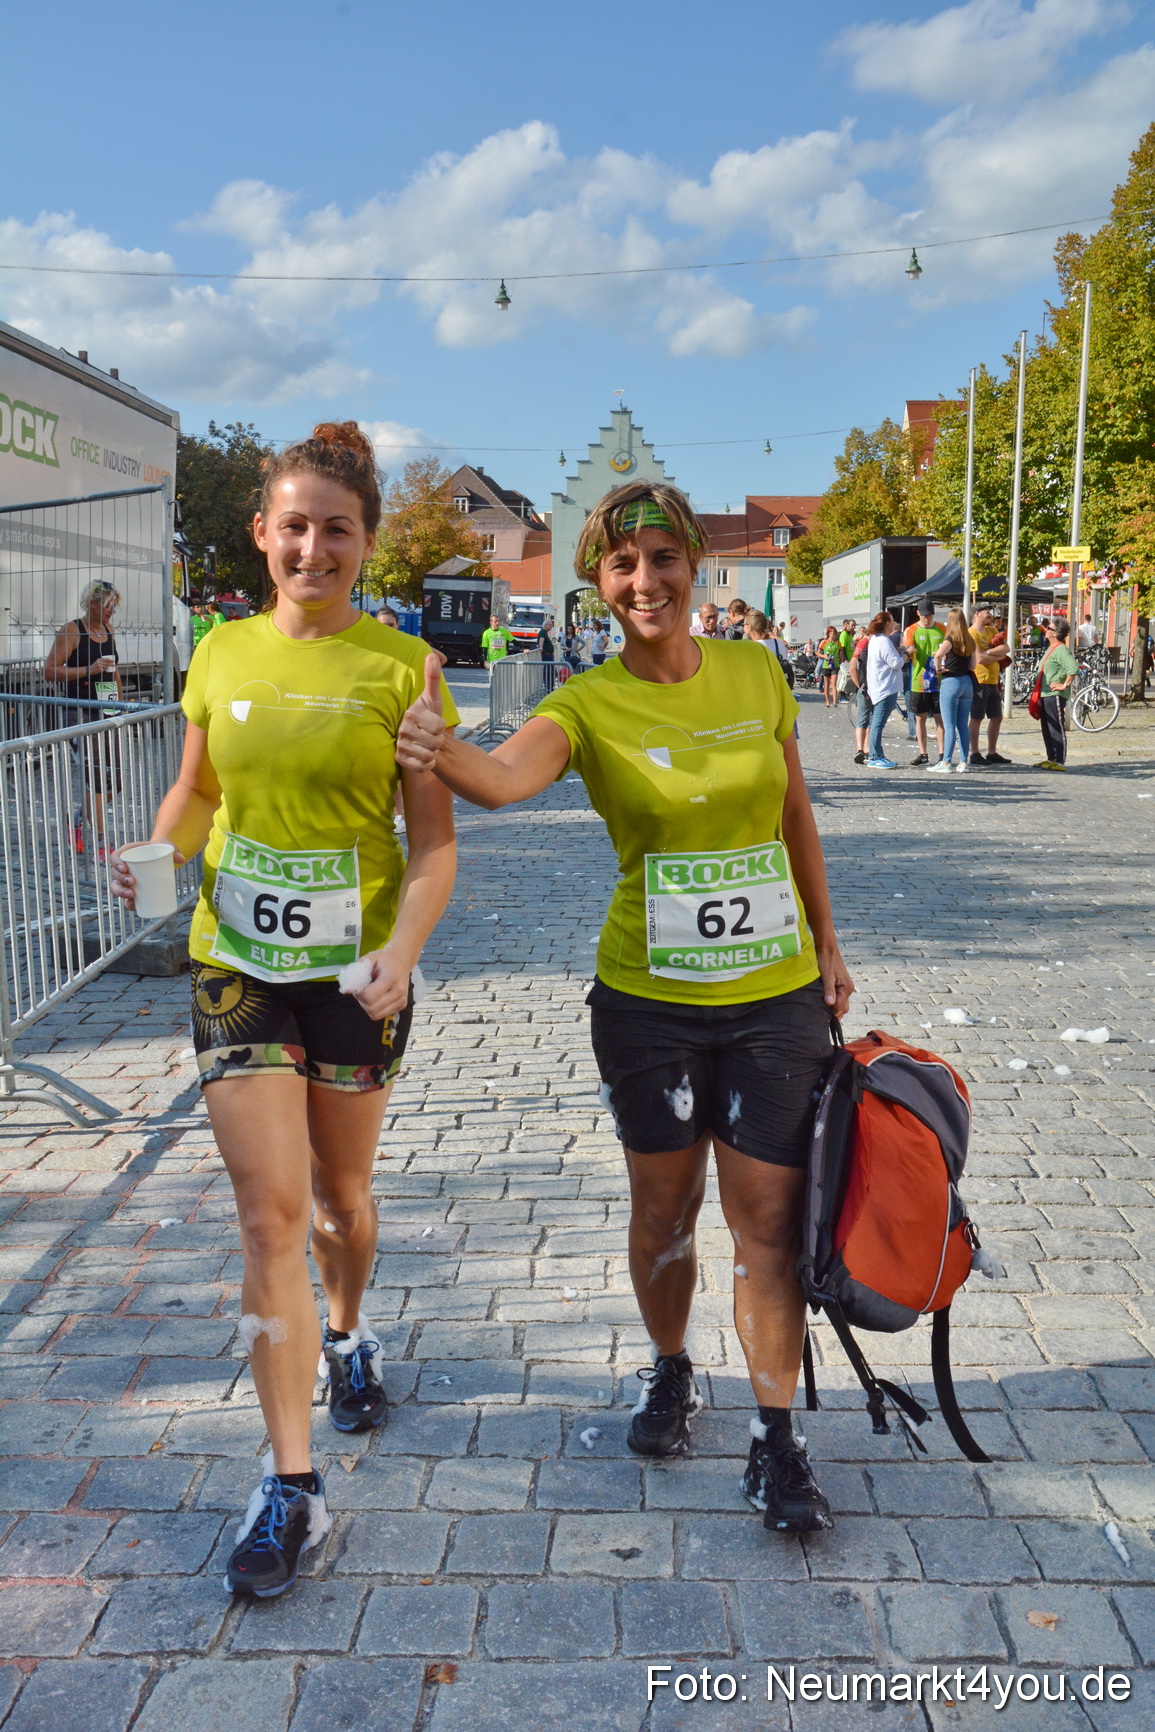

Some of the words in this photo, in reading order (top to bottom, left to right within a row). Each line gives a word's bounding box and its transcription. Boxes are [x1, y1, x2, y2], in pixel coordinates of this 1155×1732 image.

[70, 436, 100, 465] OFFICE
[103, 448, 141, 478] INDUSTRY
[440, 594, 453, 619] now
[284, 692, 313, 700] Kliniken
[693, 728, 721, 738] Kliniken
[721, 724, 732, 732] des
[715, 728, 746, 740] Neumarkt
[231, 842, 344, 887] BOCK
[659, 849, 778, 888] BOCK
[253, 893, 311, 939] 66
[345, 900, 356, 908] E6
[697, 896, 754, 939] 62
[250, 943, 311, 968] ELISA
[668, 943, 783, 968] CORNELIA
